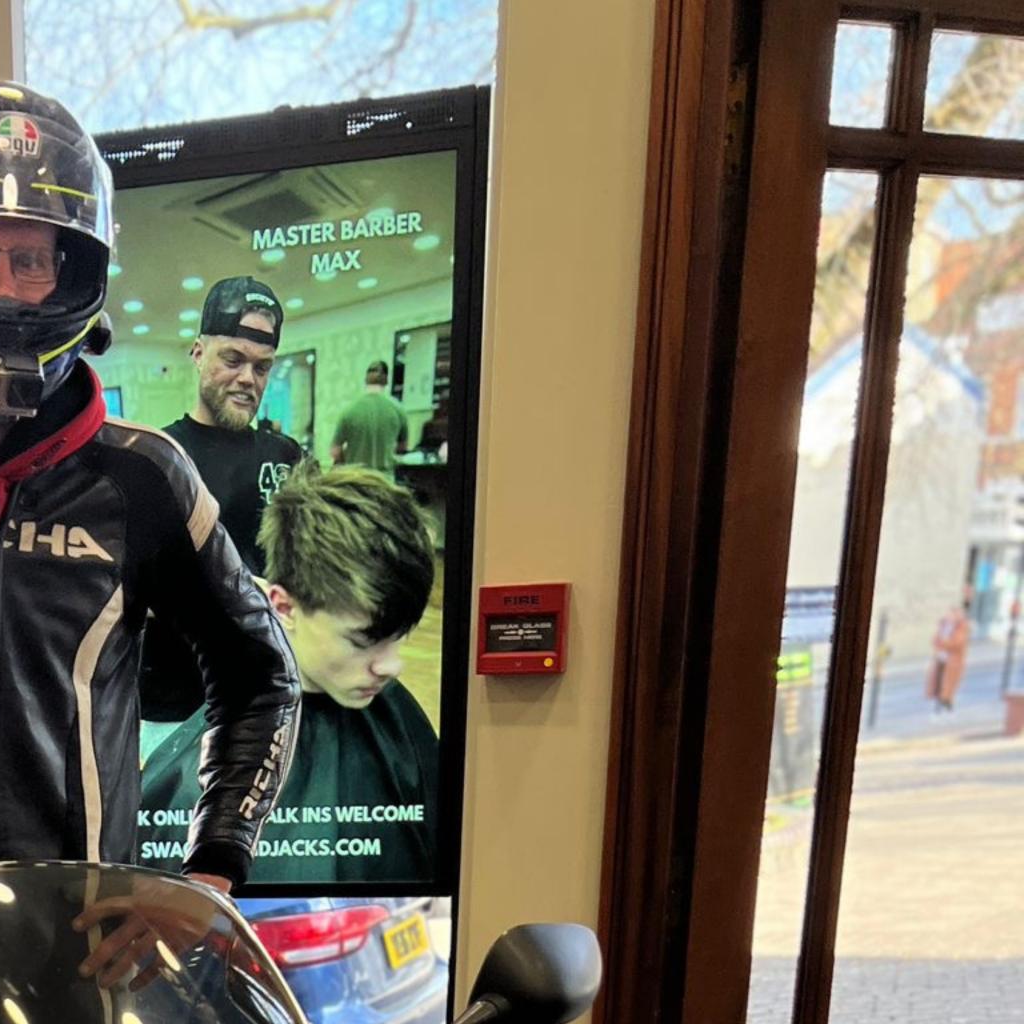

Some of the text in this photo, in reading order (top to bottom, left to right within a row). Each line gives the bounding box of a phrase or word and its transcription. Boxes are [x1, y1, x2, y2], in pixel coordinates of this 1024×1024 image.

[252, 212, 423, 251] MASTER BARBER
[311, 250, 362, 274] MAX
[503, 595, 542, 605] FIRE
[238, 722, 289, 821] RICHA
[156, 809, 193, 827] ONLI
[265, 807, 299, 824] ALK
[303, 806, 331, 823] INS
[336, 804, 425, 822] WELCOME
